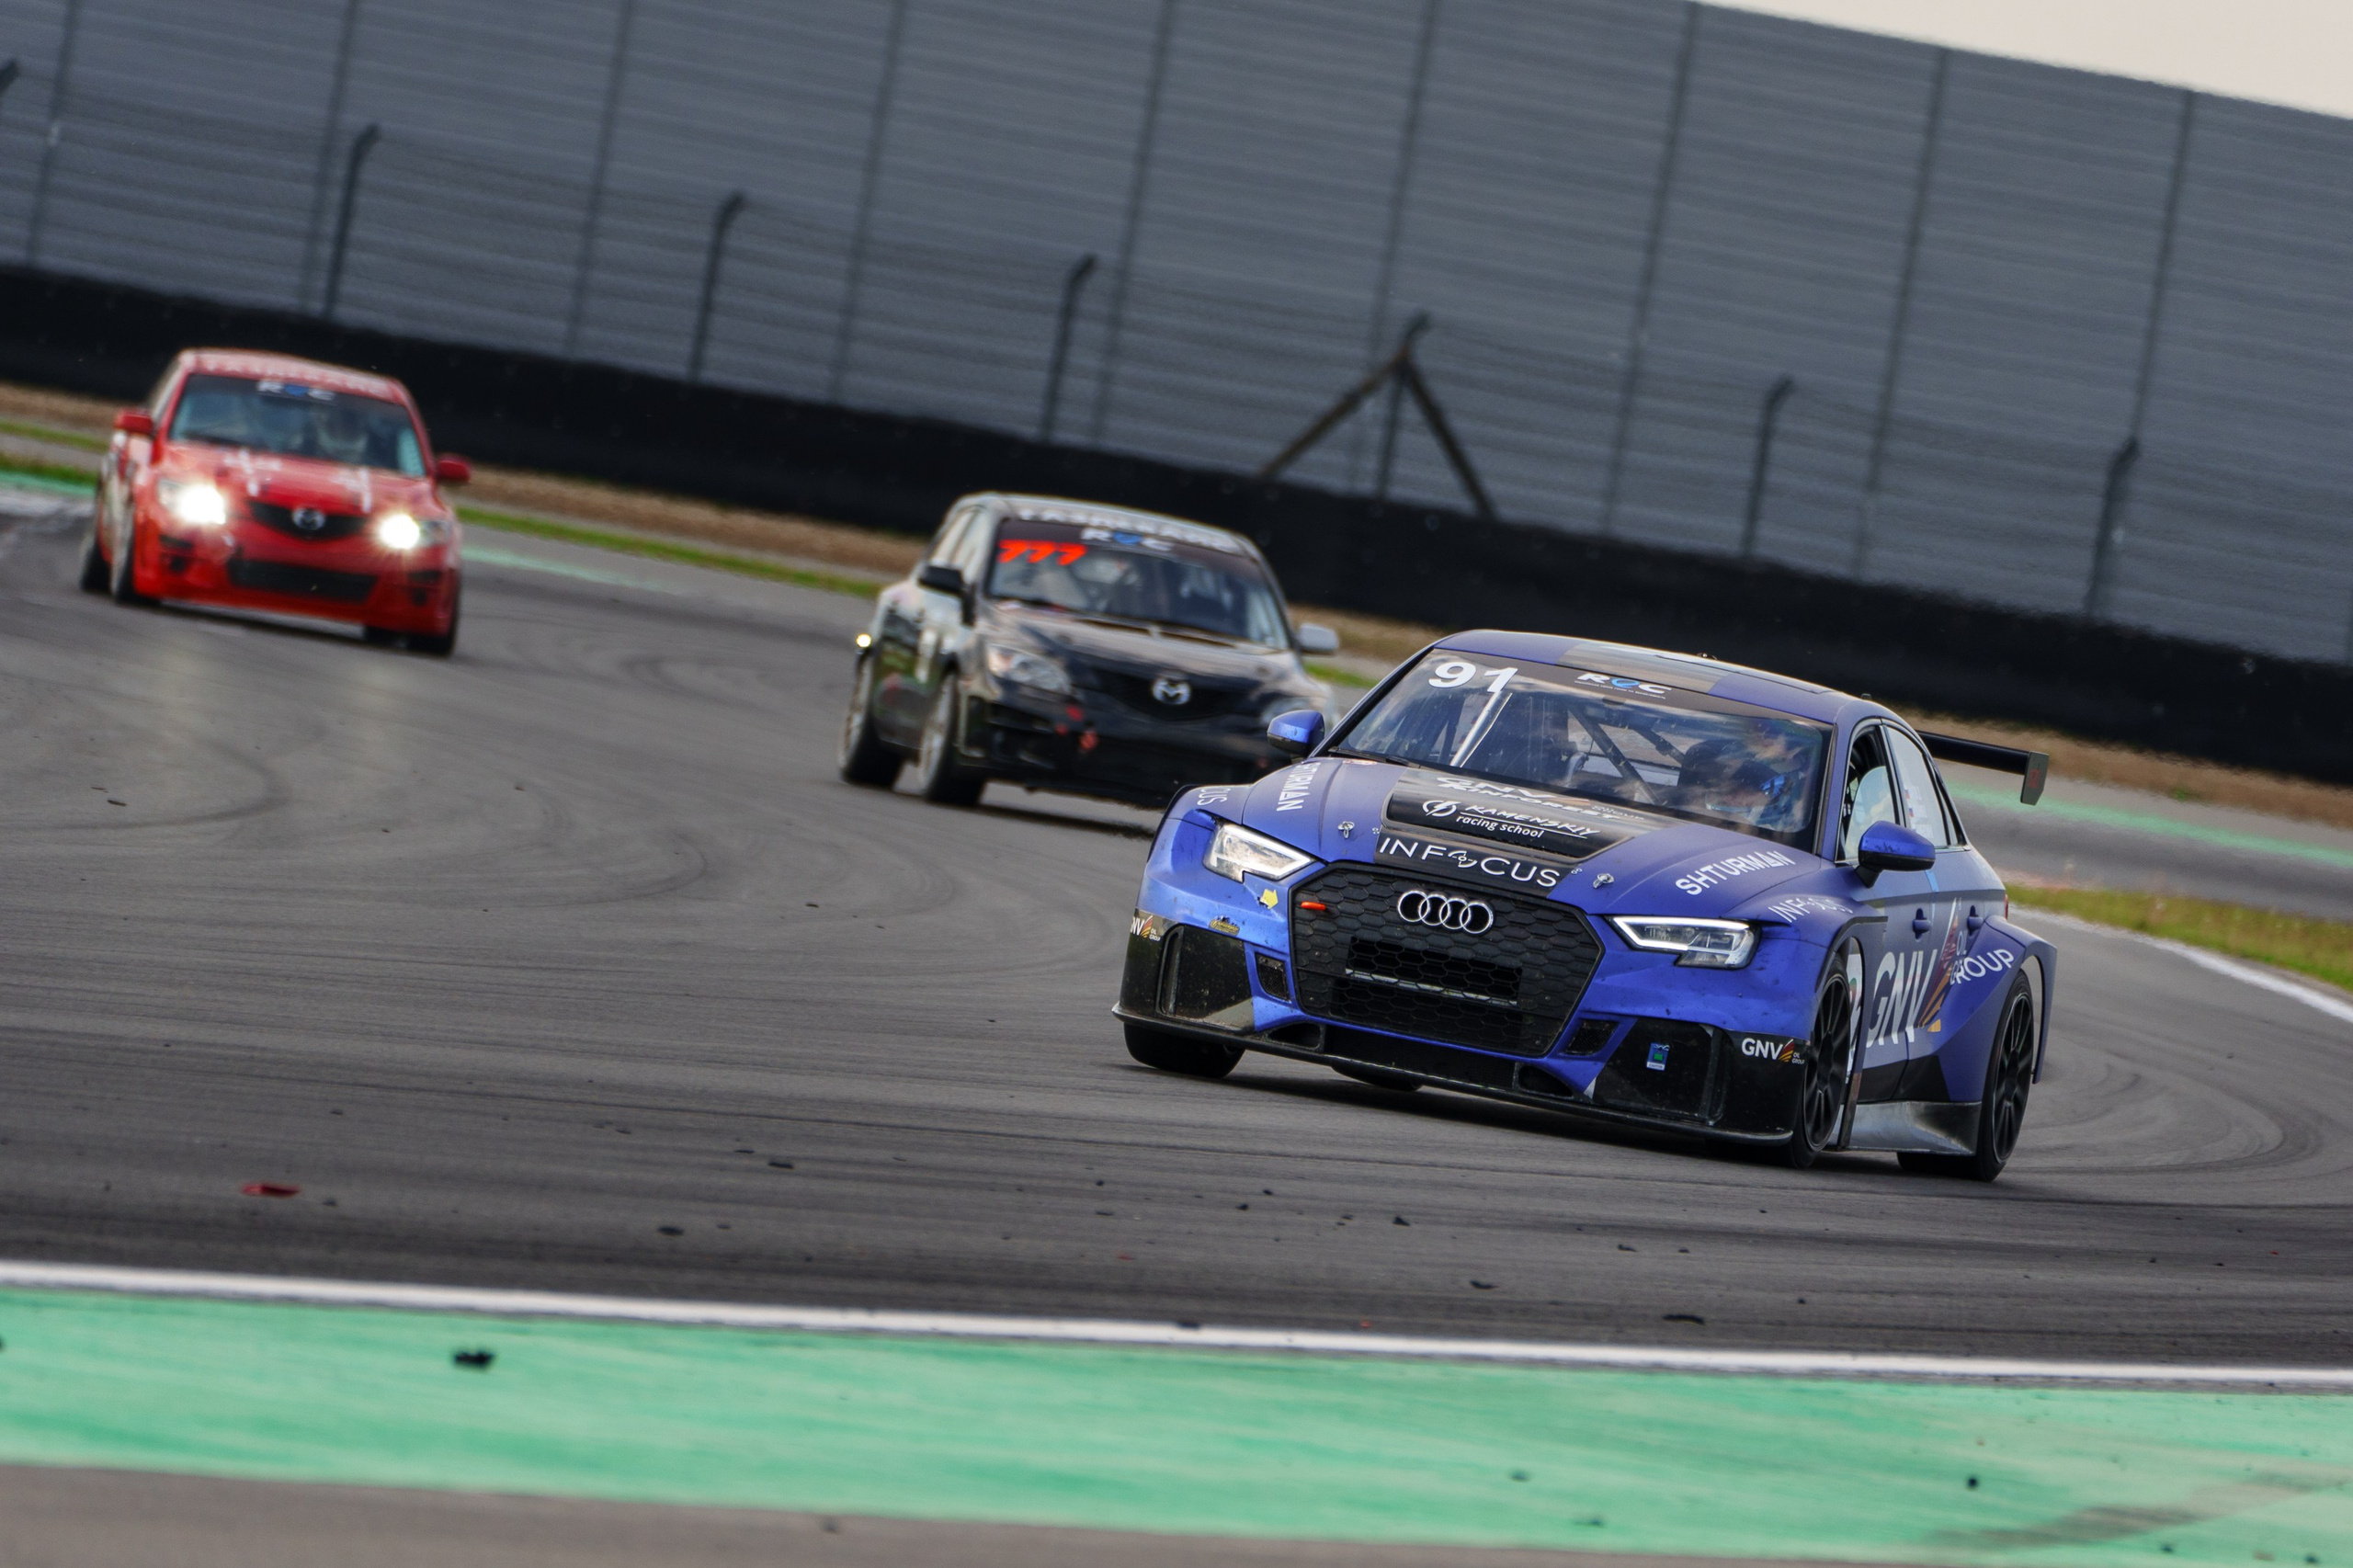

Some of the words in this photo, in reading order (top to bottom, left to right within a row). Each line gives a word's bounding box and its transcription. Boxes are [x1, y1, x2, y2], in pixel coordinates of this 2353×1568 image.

[998, 539, 1086, 565] 777
[1428, 662, 1518, 693] 91
[1577, 673, 1672, 695] ROC
[1437, 777, 1557, 799] GNV
[1456, 815, 1496, 831] racing
[1500, 823, 1545, 838] school
[1465, 805, 1600, 836] KAMENSKIY
[1380, 837, 1561, 888] INFOCUS
[1676, 851, 1796, 896] SHTURMAN
[1866, 949, 1938, 1049] GNV
[1742, 1038, 1784, 1060] GNV
